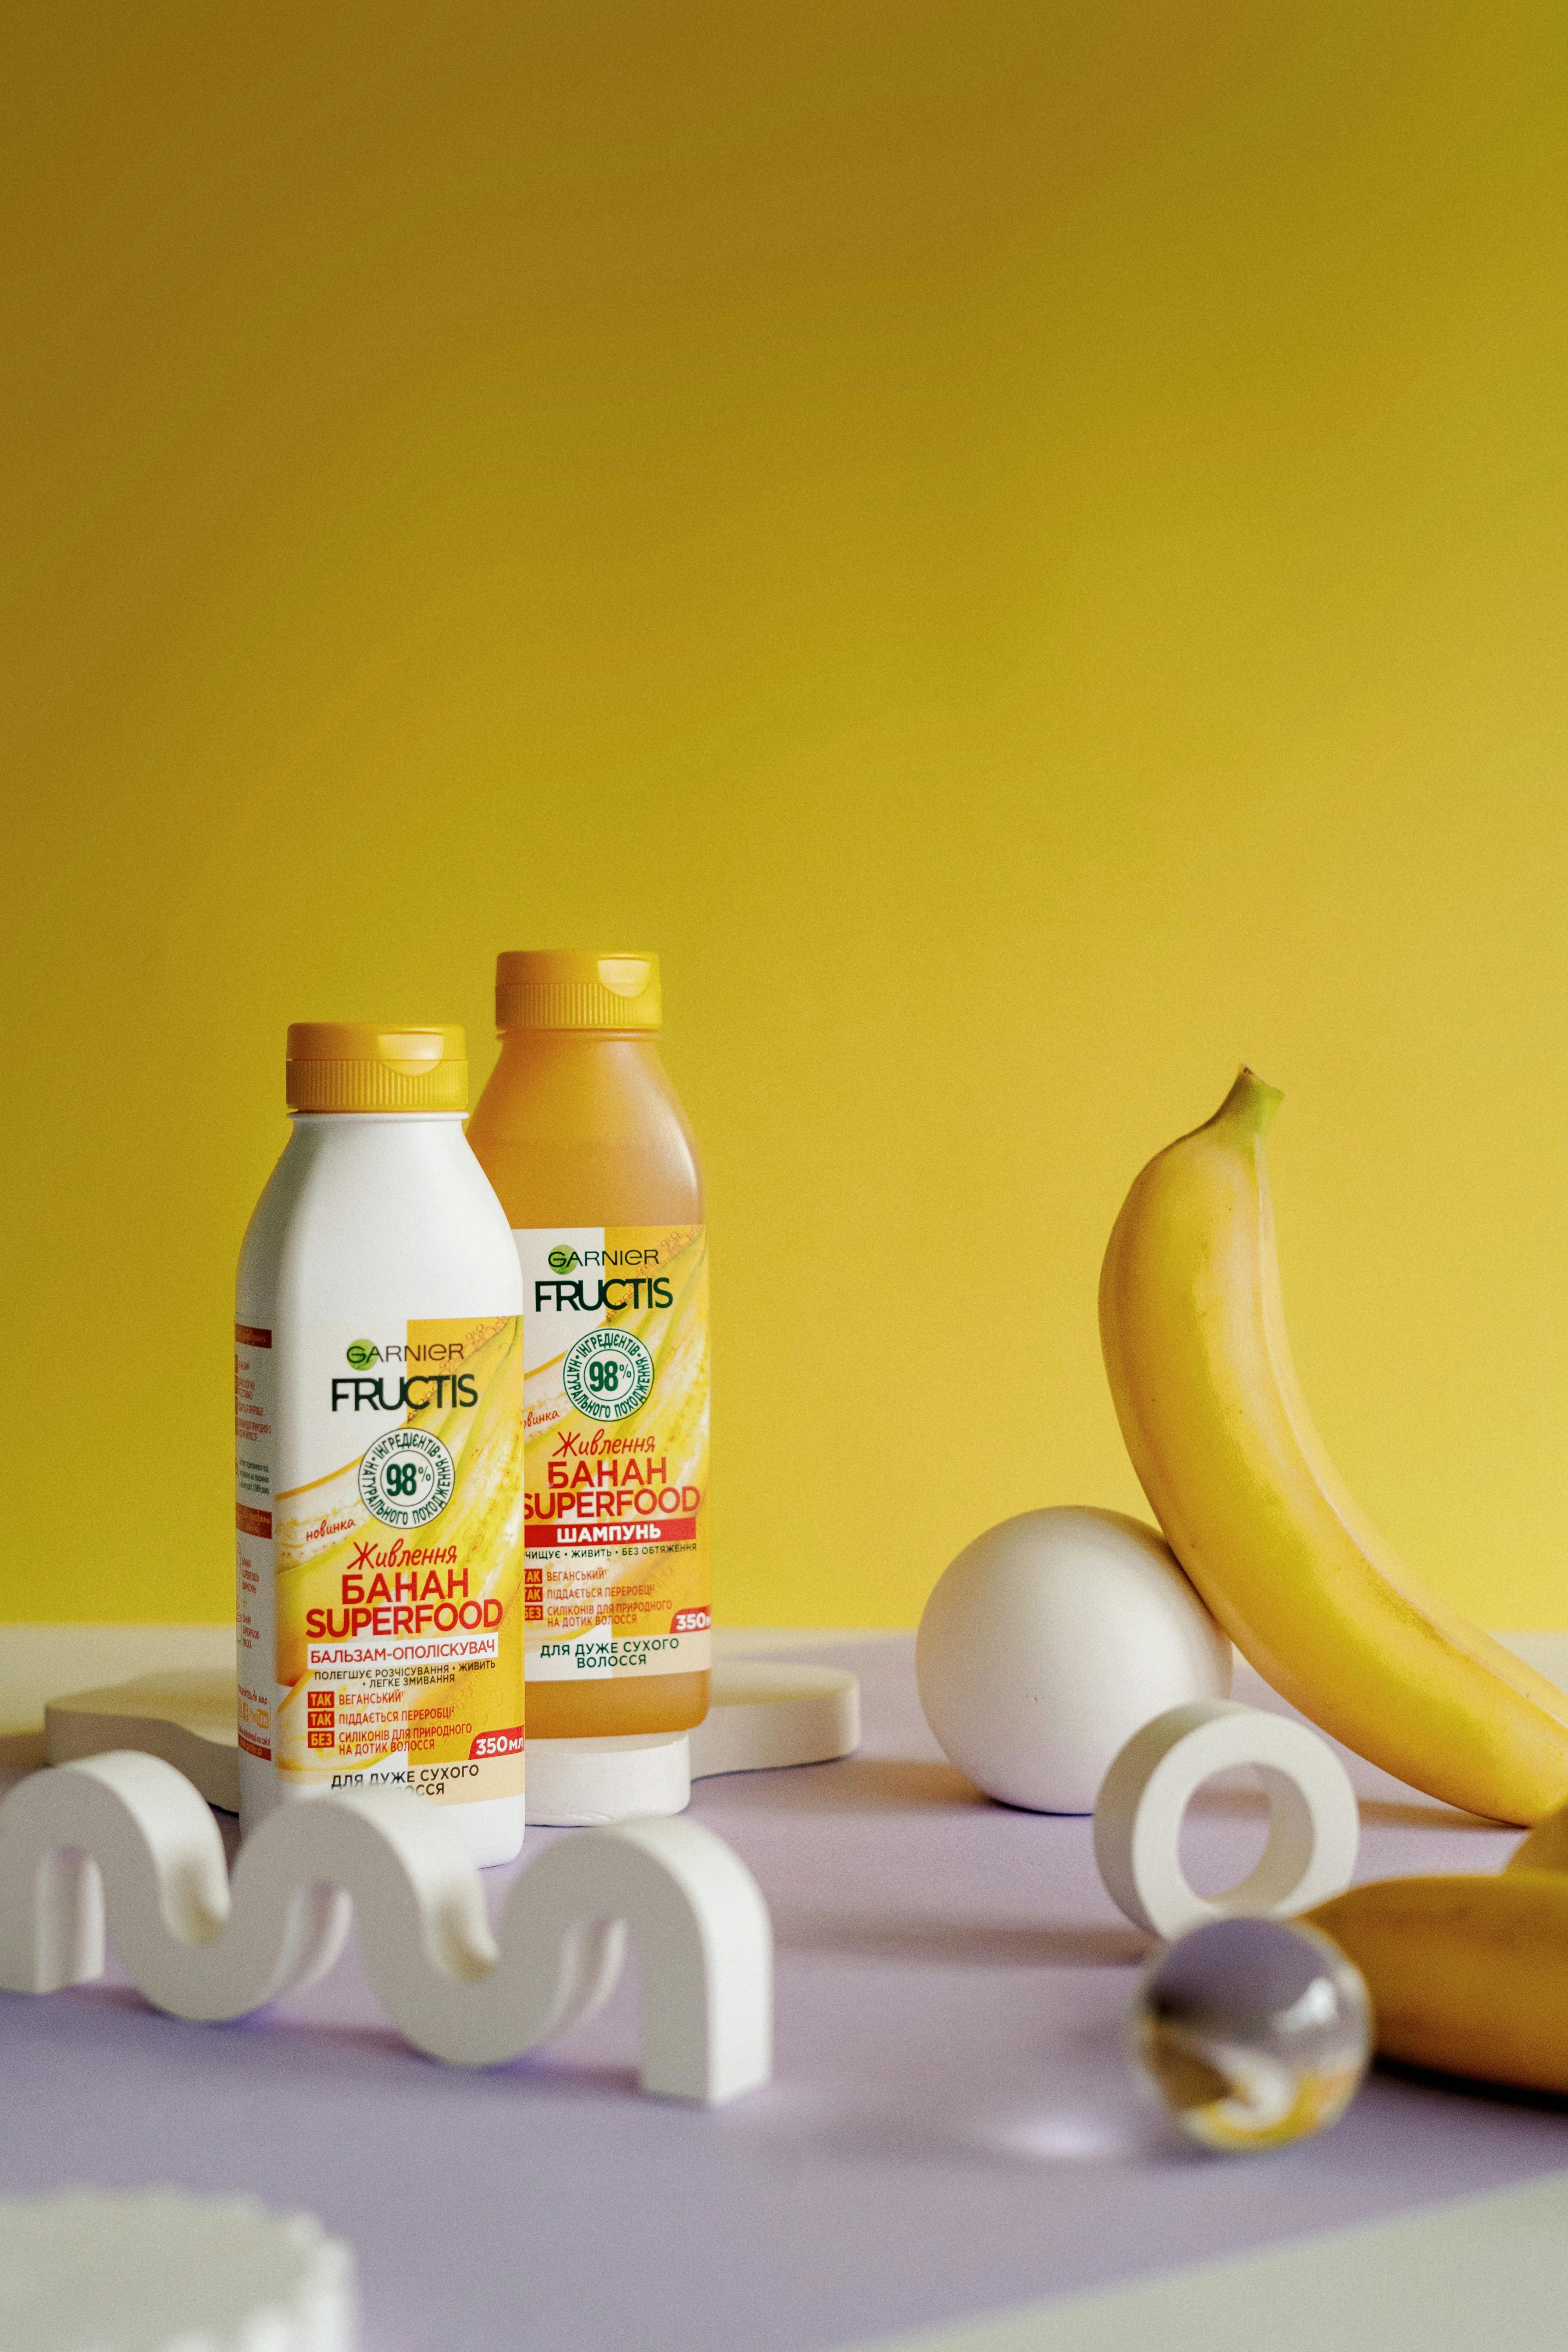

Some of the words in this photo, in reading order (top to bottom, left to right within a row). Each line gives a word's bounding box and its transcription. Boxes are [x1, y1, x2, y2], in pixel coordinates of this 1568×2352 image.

[548, 1249, 659, 1268] GARNIER
[535, 1277, 673, 1312] FRUCTIS
[347, 1343, 464, 1363] GARNIER
[576, 1333, 640, 1358] ІНГРЕДІЄНТІВ
[567, 1359, 610, 1418] НАТУРАЛЬНОГО
[614, 1356, 651, 1417] ПОХОДЖЕННЯ
[589, 1361, 632, 1392] 98%
[332, 1374, 478, 1411] FRUCTIS
[372, 1433, 441, 1459] ІНГРЕДІЄНТІВ
[552, 1428, 655, 1458] Живлення
[387, 1463, 431, 1496] 98%
[548, 1457, 666, 1489] БАНАН
[362, 1461, 408, 1525] НАТУРАЛЬНОГО
[412, 1458, 451, 1524] ПОХОДЖЕННЯ
[524, 1486, 700, 1519] SUPERFOOD
[306, 1517, 356, 1541] новинка
[557, 1524, 662, 1543] ШАМПУНЬ
[347, 1538, 457, 1570] Живлення
[572, 1549, 612, 1558] ЖИВИТЬ
[622, 1548, 639, 1556] БЕЗ
[642, 1543, 697, 1555] ОБТЯЖЕННЯ
[342, 1568, 468, 1604] БАНАН
[547, 1588, 602, 1600] ПІДДАЄТЬСЯ
[306, 1598, 503, 1638] SUPERFOOD
[548, 1605, 593, 1616] СИЛІКОНІВ
[597, 1604, 614, 1615] ДЛЯ
[616, 1600, 672, 1613] ПРИРОДНОГО
[548, 1618, 559, 1627] НА
[563, 1616, 592, 1628] ДОТИК
[596, 1614, 637, 1626] ВОЛОССЯ
[310, 1639, 495, 1664] БАЛЬЗАМ-ОПОЛІСКУВАЧ
[540, 1644, 570, 1658] ДЛЯ
[575, 1641, 618, 1657] ДУЖЕ
[623, 1637, 679, 1653] СУХОГО
[315, 1670, 372, 1680] ПОЛЕГШУЄ
[376, 1665, 449, 1677] РОЗЧІСУВАННЯ
[459, 1660, 495, 1671] ЖИВИТЬ
[577, 1654, 646, 1668] ВОЛОССЯ
[370, 1678, 400, 1688] ЛЕГКЕ
[403, 1674, 455, 1686] ЗМИВАННЯ
[310, 1693, 331, 1706] ТАК
[310, 1713, 332, 1726] ТАК
[339, 1711, 398, 1725] ПІДДАЄТЬСЯ
[311, 1733, 332, 1746] БЕЗ
[339, 1730, 389, 1742] СИЛІКОНІВ
[392, 1728, 410, 1741] ДЛЯ
[413, 1723, 472, 1738] ПРИРОДНОГО
[339, 1744, 352, 1755] НА
[355, 1742, 388, 1756] ДОТИК
[390, 1739, 435, 1753] ВОЛОССЯ
[331, 1773, 364, 1789] ДЛЯ
[420, 1764, 479, 1782] СУХОГО
